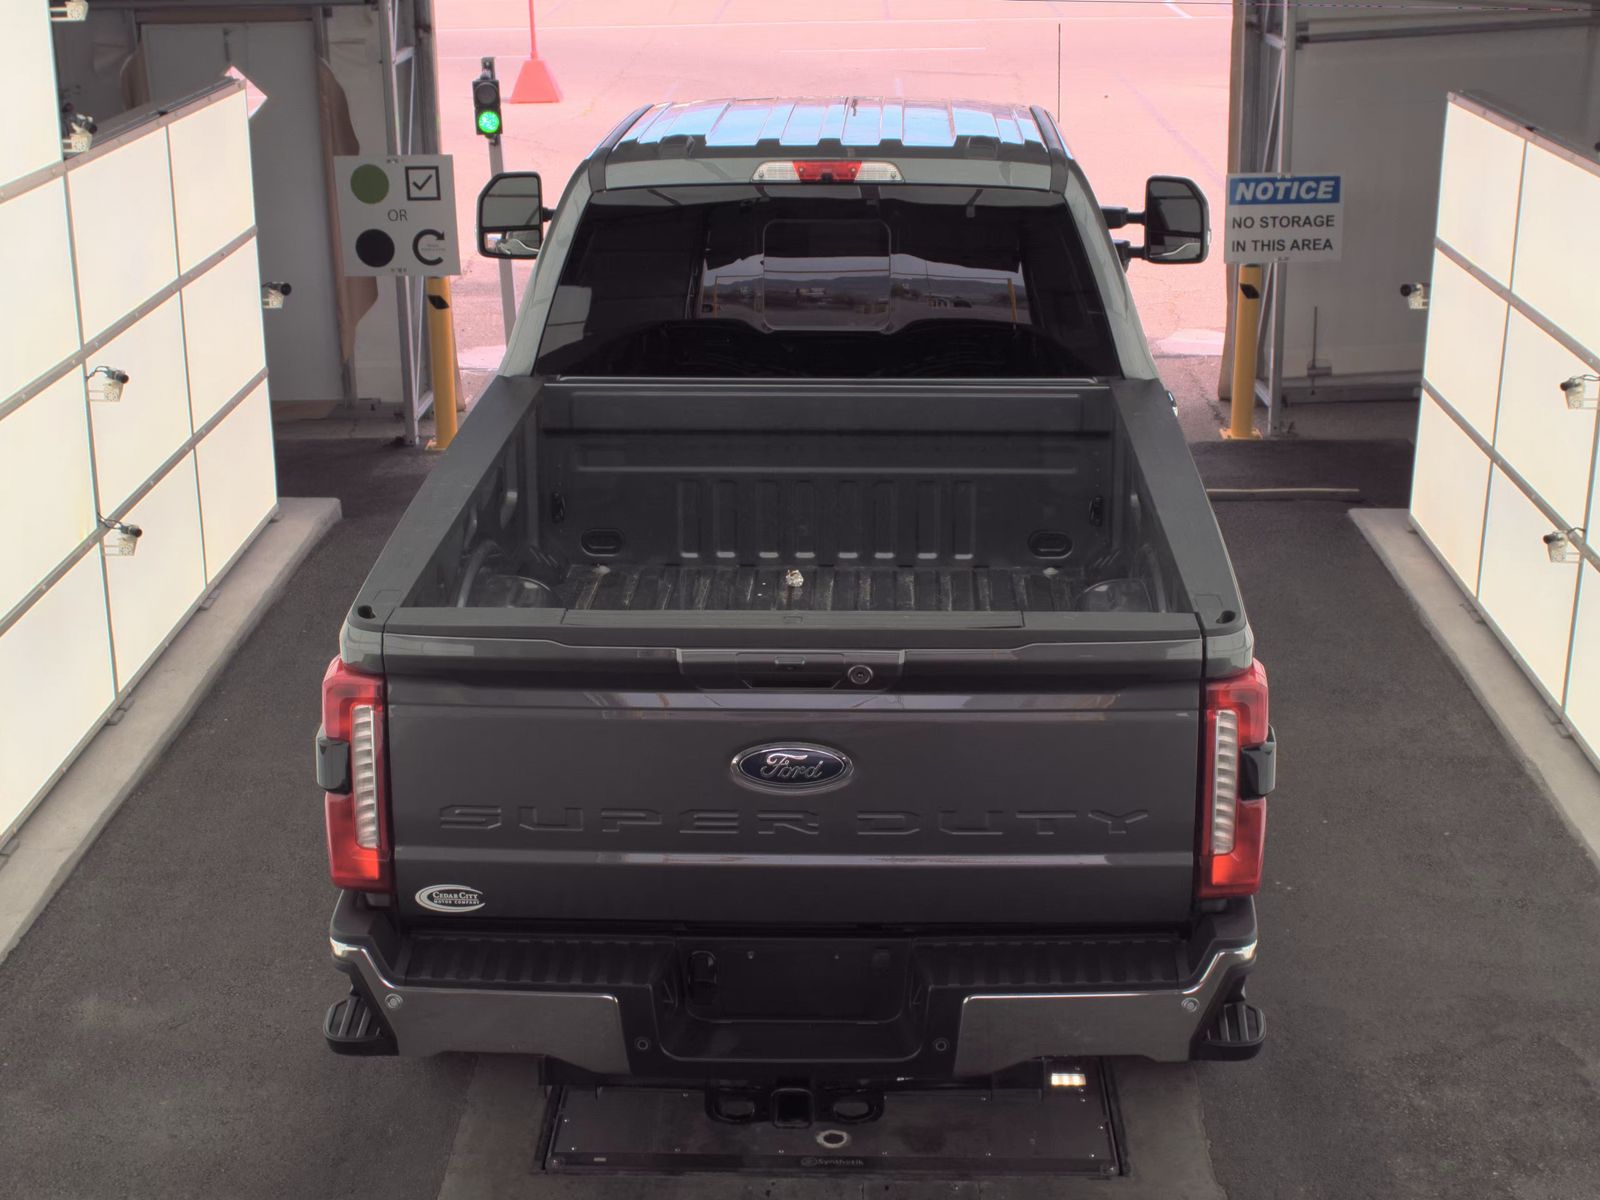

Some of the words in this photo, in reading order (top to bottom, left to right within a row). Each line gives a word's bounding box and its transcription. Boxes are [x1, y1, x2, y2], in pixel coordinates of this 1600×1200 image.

[1235, 180, 1335, 201] NOTICE
[387, 208, 408, 222] OR
[1232, 216, 1255, 229] NO
[1259, 215, 1335, 229] STORAGE
[1232, 240, 1246, 252] IN
[1251, 239, 1286, 252] THIS
[1290, 238, 1333, 251] AREA
[760, 752, 824, 778] Ford
[438, 804, 819, 835] SUPER
[856, 809, 1149, 836] DUTY
